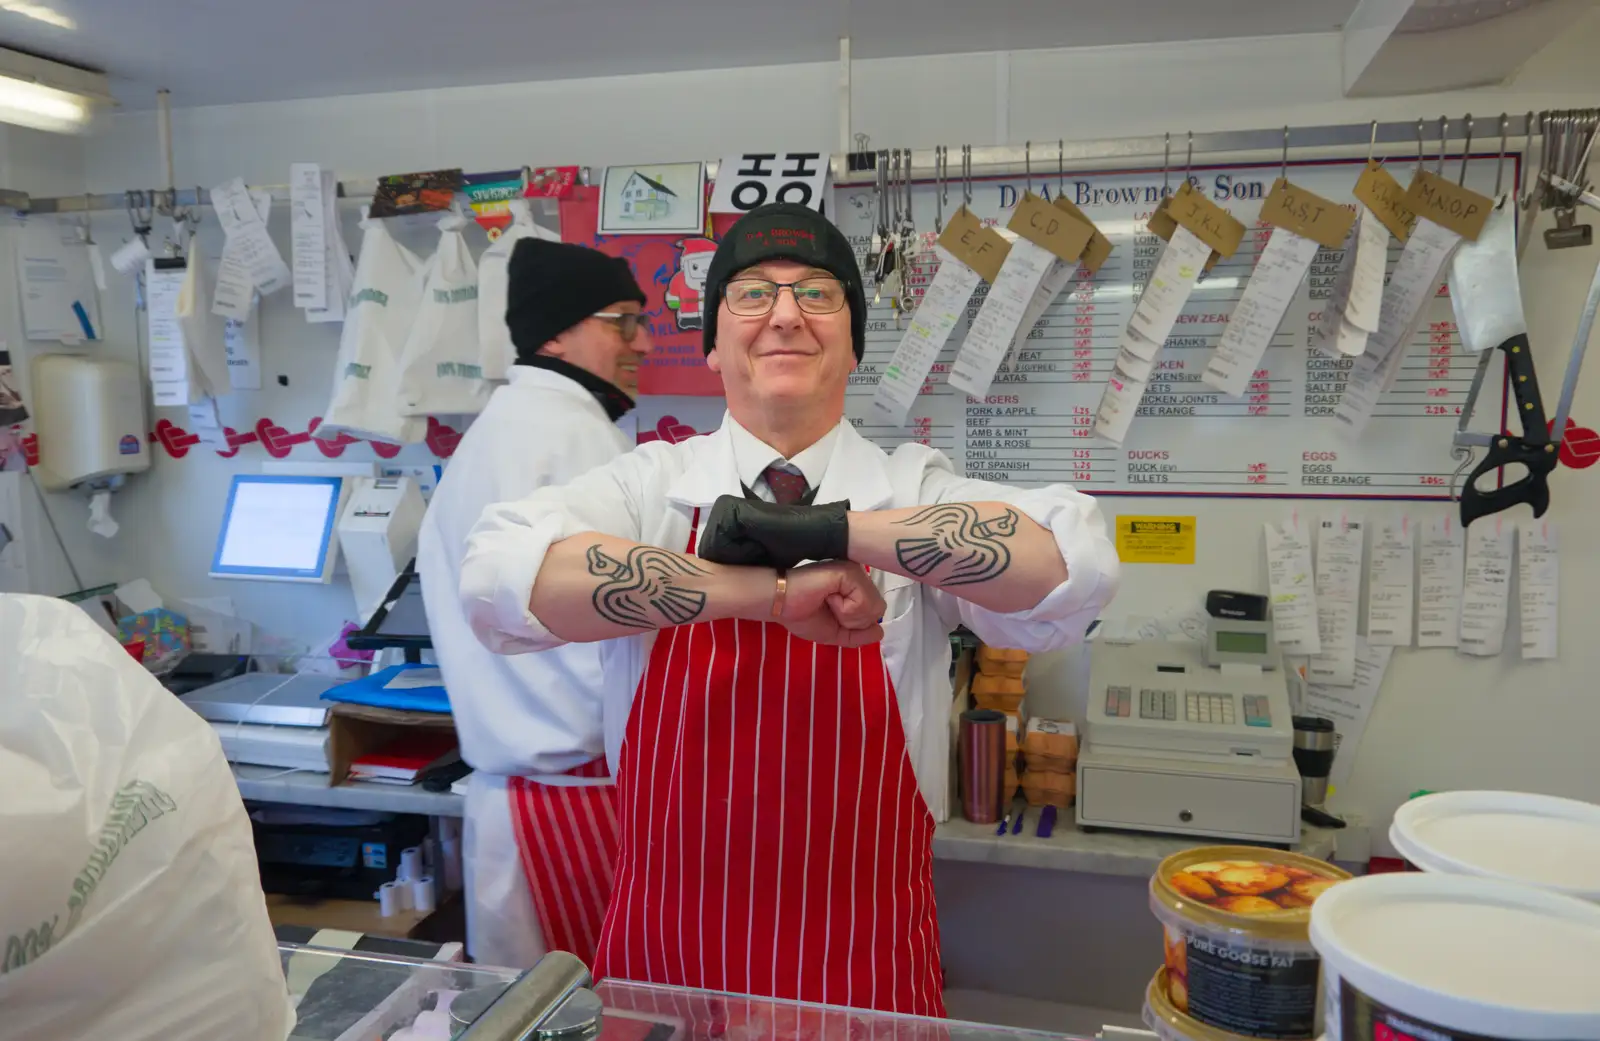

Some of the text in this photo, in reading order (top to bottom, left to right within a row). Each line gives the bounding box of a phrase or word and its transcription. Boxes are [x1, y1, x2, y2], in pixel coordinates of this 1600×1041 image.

[1214, 174, 1263, 200] Son
[1306, 371, 1350, 381] TURKEY
[1305, 384, 1330, 393] SALT
[1180, 395, 1218, 404] JOINTS
[1304, 396, 1341, 405] ROAST
[966, 407, 993, 416] PORK
[1005, 407, 1037, 415] APPLE
[1158, 407, 1196, 415] RANGE
[966, 418, 991, 426] BEEF
[966, 429, 992, 437] LAMB
[966, 450, 997, 458] CHILLI
[1128, 451, 1169, 460] DUCKS
[1302, 452, 1337, 461] EGGS
[988, 462, 1030, 470] SPANISH
[1128, 463, 1156, 471] DUCK
[1302, 464, 1333, 472] EGGS
[966, 472, 1009, 480] VENISON
[1128, 475, 1168, 483] FILLETS
[1302, 476, 1371, 484] FREE RANGE
[1218, 947, 1269, 966] GOOSE
[1271, 955, 1294, 968] FAT
